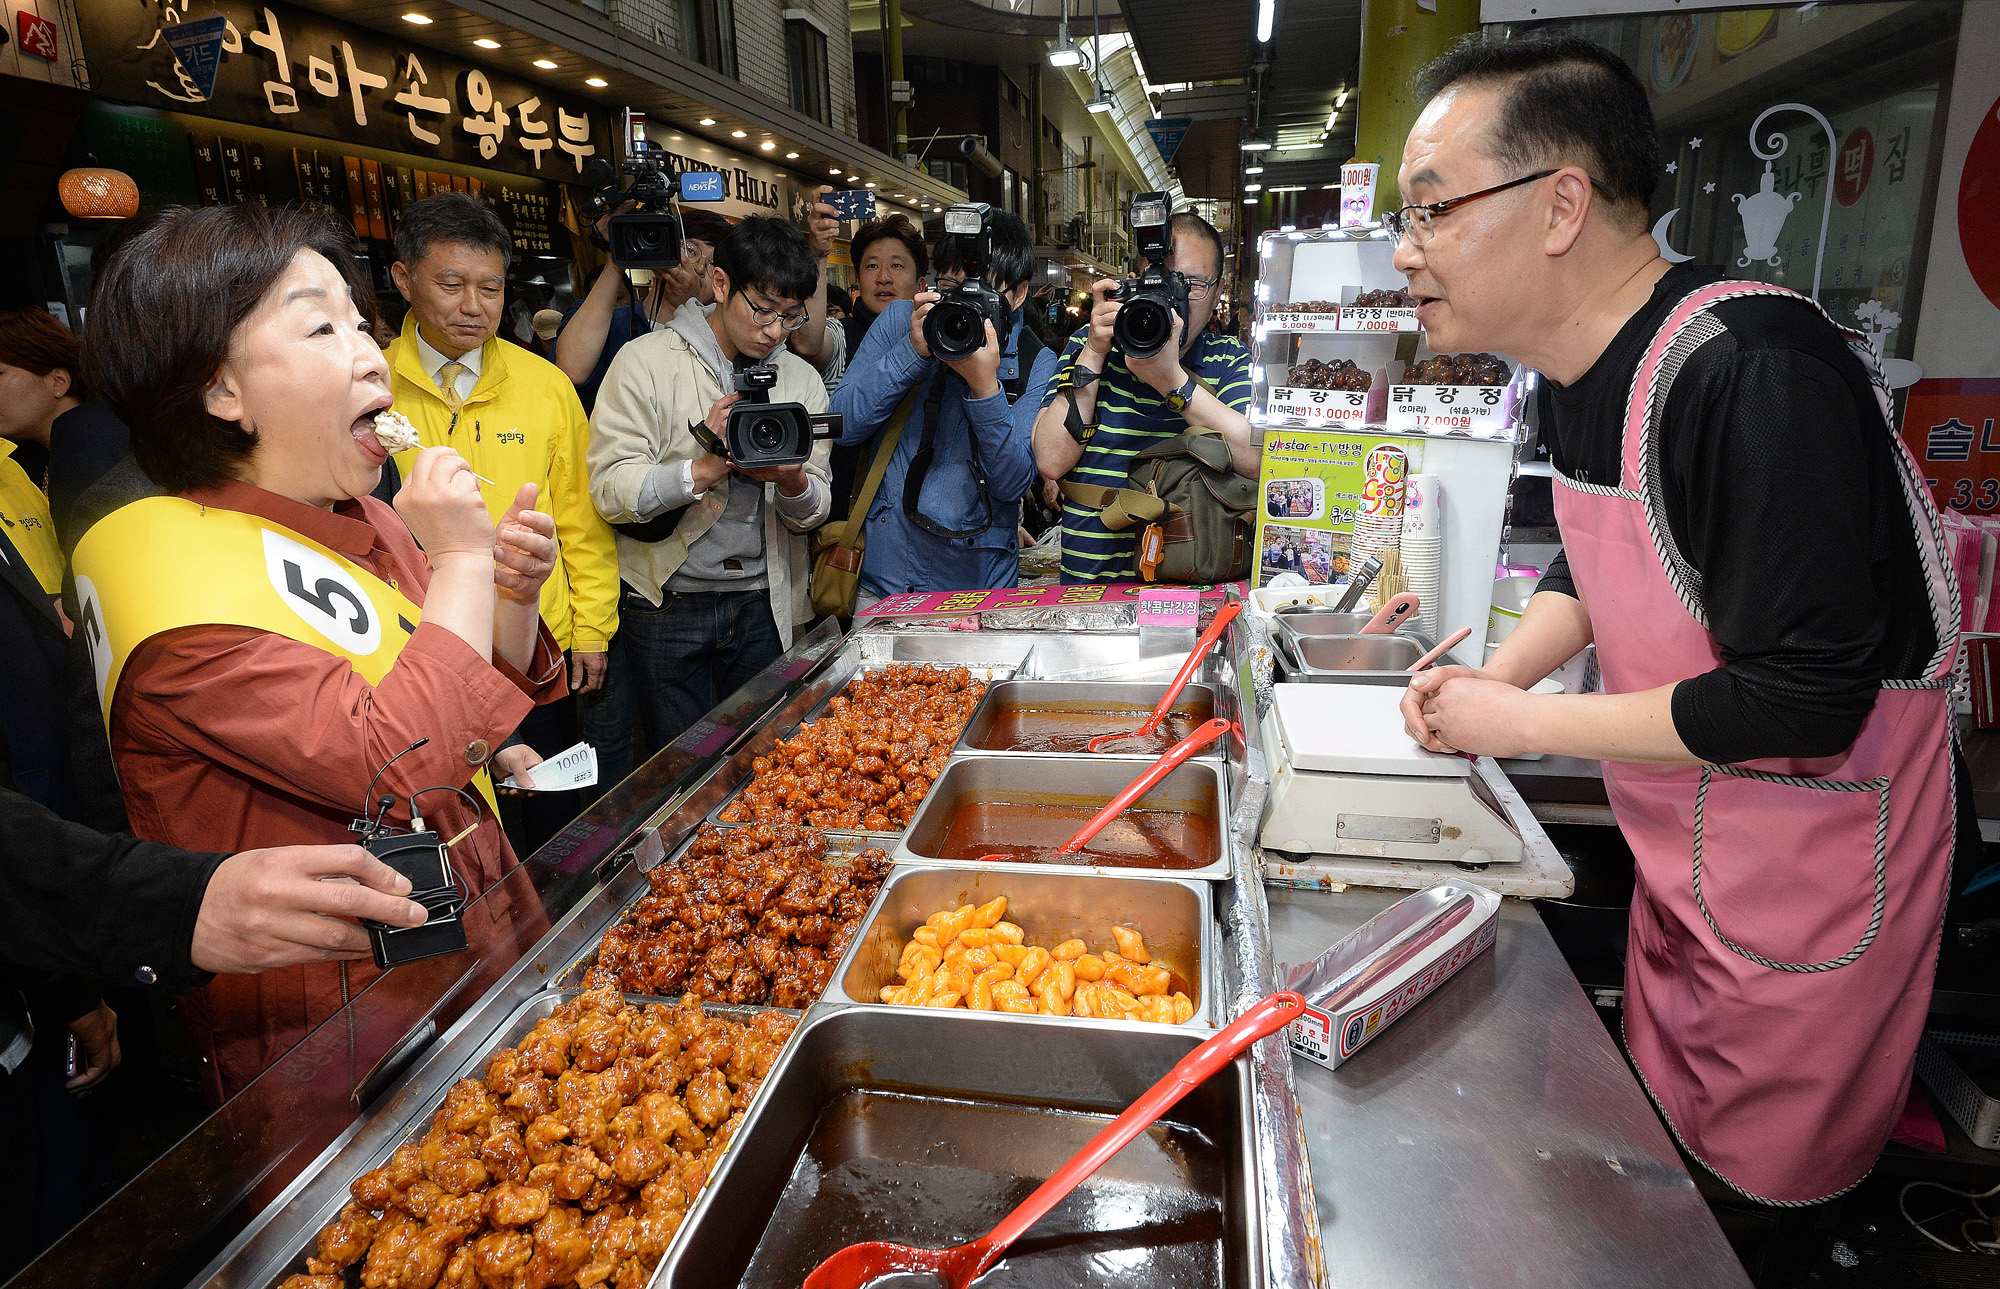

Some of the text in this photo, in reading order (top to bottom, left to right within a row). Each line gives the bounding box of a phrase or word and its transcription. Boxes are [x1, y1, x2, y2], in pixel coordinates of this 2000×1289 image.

[184, 44, 214, 66] 카드
[226, 148, 245, 202] 냉면육
[734, 167, 779, 209] HILLS
[1266, 313, 1300, 321] 닭강정
[1342, 308, 1382, 319] 닭강정
[1356, 320, 1399, 331] 7,000원
[1398, 405, 1427, 414] (2마리)
[496, 432, 525, 445] 정의당
[283, 559, 370, 635] 5
[1139, 596, 1197, 615] 핫콤닭강정
[556, 749, 588, 772] 1000
[1294, 1032, 1321, 1051] 30m
